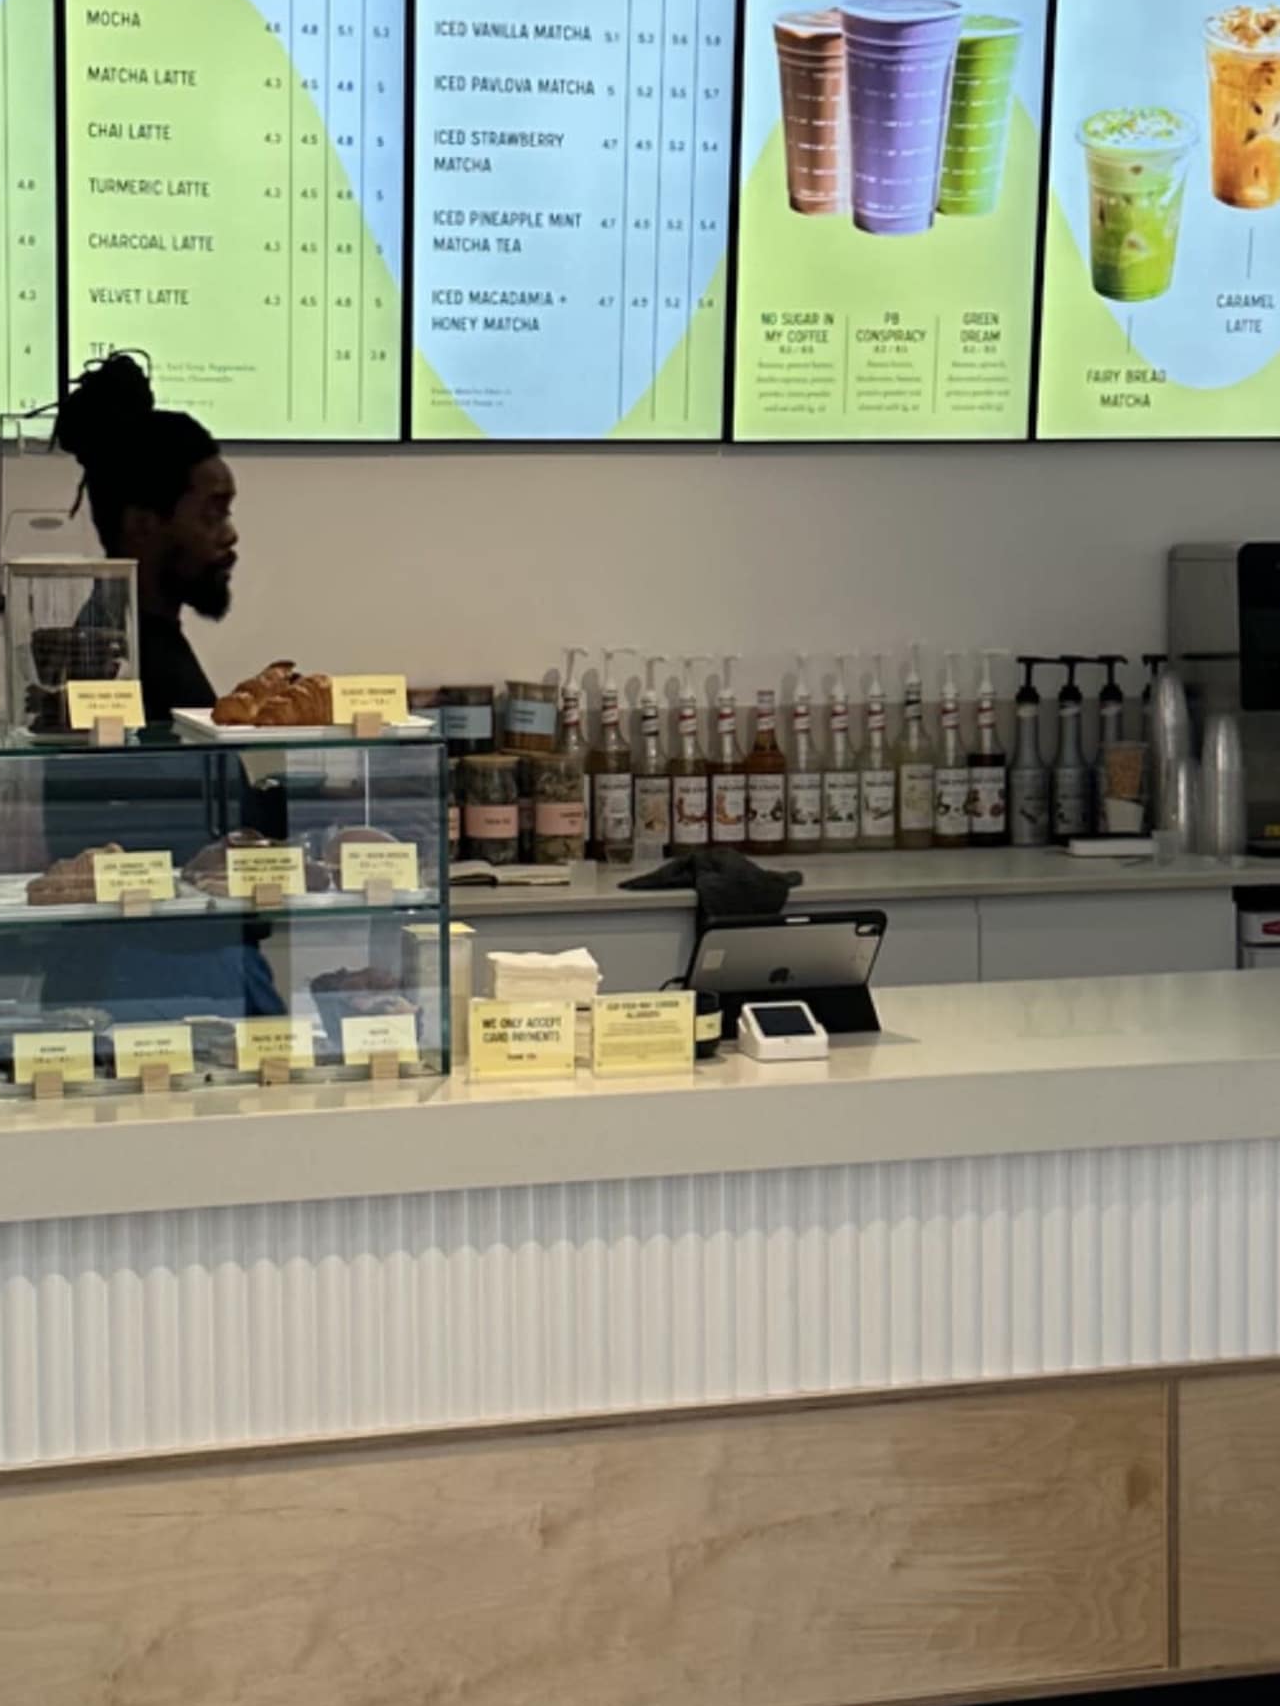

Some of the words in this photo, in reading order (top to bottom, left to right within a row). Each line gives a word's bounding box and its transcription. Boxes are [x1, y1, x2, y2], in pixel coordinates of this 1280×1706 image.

[86, 10, 140, 27] MOCHA
[435, 21, 467, 37] ICED
[473, 22, 528, 39] VANILLA
[533, 24, 591, 41] MATCHA
[88, 66, 148, 84] MATCHA
[154, 70, 197, 86] LATTE
[434, 76, 466, 91] ICED
[472, 76, 532, 93] PAVLOVA
[538, 79, 594, 95] MATCHA
[88, 123, 123, 138] CHAI
[129, 124, 171, 140] LATTE
[434, 129, 465, 145] ICED
[472, 131, 564, 147] STRAWBERRY
[434, 157, 492, 173] MATCHA
[89, 177, 162, 195] TURMERIC
[168, 181, 210, 198] LATTE
[433, 210, 465, 226] ICED
[470, 211, 542, 228] PINEAPPLE
[549, 213, 582, 228] MINT
[89, 233, 166, 250] CHARCOAL
[172, 236, 214, 252] LATTE
[433, 237, 490, 252] MATCHA
[497, 238, 521, 253] TEA
[90, 289, 141, 304] VELVET
[148, 290, 189, 306] LATTE
[432, 290, 463, 305] ICED
[469, 291, 553, 306] MACADAMIA
[1217, 294, 1274, 309] CARAMEL
[432, 317, 477, 331] HONEY
[483, 318, 540, 331] MATCHA
[762, 313, 777, 325] NO
[782, 313, 819, 325] SUGAR
[963, 313, 999, 325] GREEN
[1226, 319, 1262, 333] LATTE
[765, 330, 782, 342] MY
[787, 330, 828, 342] COFFEE
[856, 330, 926, 342] CONSPIRACY
[960, 330, 1001, 341] DREAM
[90, 342, 116, 359] TEA
[1087, 369, 1121, 382] FAIRY
[1126, 369, 1166, 383] BREAD
[1101, 394, 1150, 407] MATCHA
[482, 1018, 496, 1029] WE
[500, 1018, 522, 1029] ONLY
[527, 1016, 562, 1028] ACCEPT
[483, 1031, 508, 1043] CARD
[512, 1031, 560, 1042] PAYMENTS
